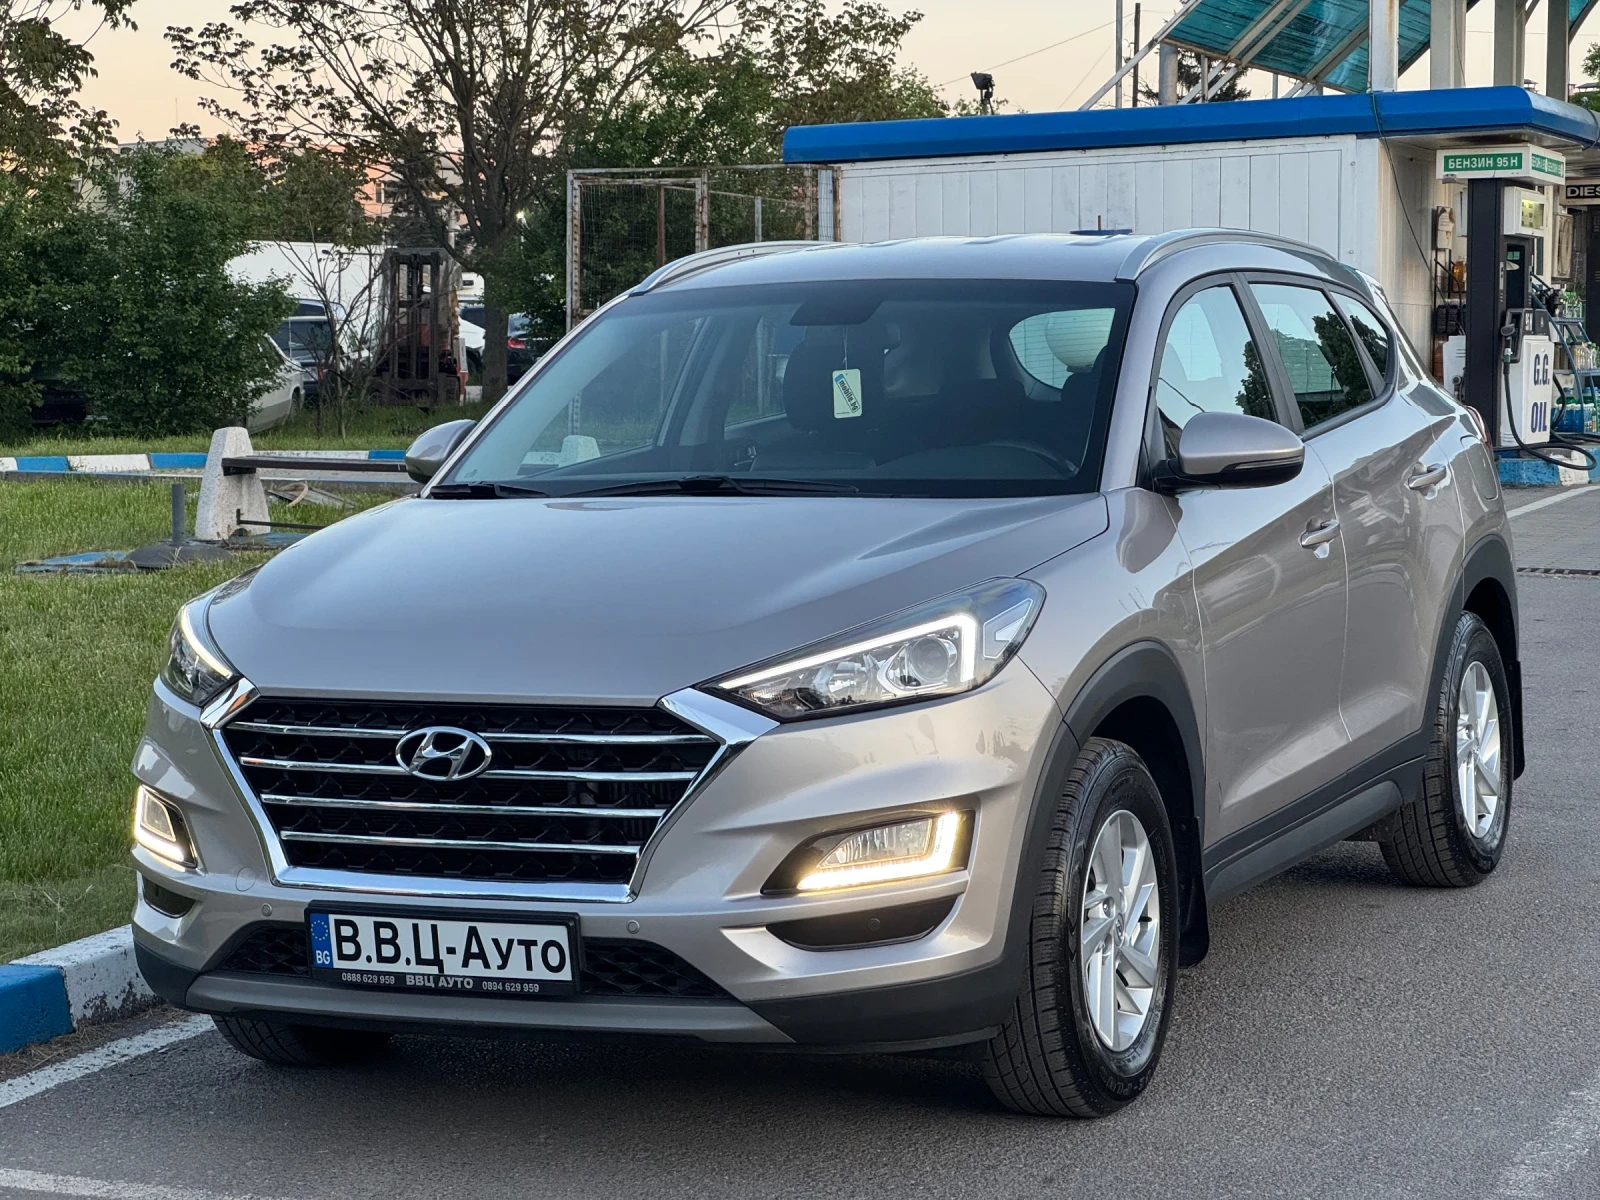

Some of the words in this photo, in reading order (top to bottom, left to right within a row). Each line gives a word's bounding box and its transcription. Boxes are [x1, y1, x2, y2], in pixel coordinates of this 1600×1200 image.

[1448, 157, 1494, 169] БЕНЗИН
[839, 380, 858, 411] mobile.bg
[1531, 401, 1547, 433] OIL
[315, 950, 331, 965] BG
[334, 918, 567, 974] В.В.Ц-Ауто
[341, 972, 361, 982] 0888
[362, 974, 378, 984] 629
[380, 975, 395, 984] 959
[405, 974, 435, 988] ВВЦ
[438, 976, 474, 989] АУТО
[482, 981, 503, 991] 0894
[505, 982, 521, 992] 629
[522, 983, 540, 992] 959
